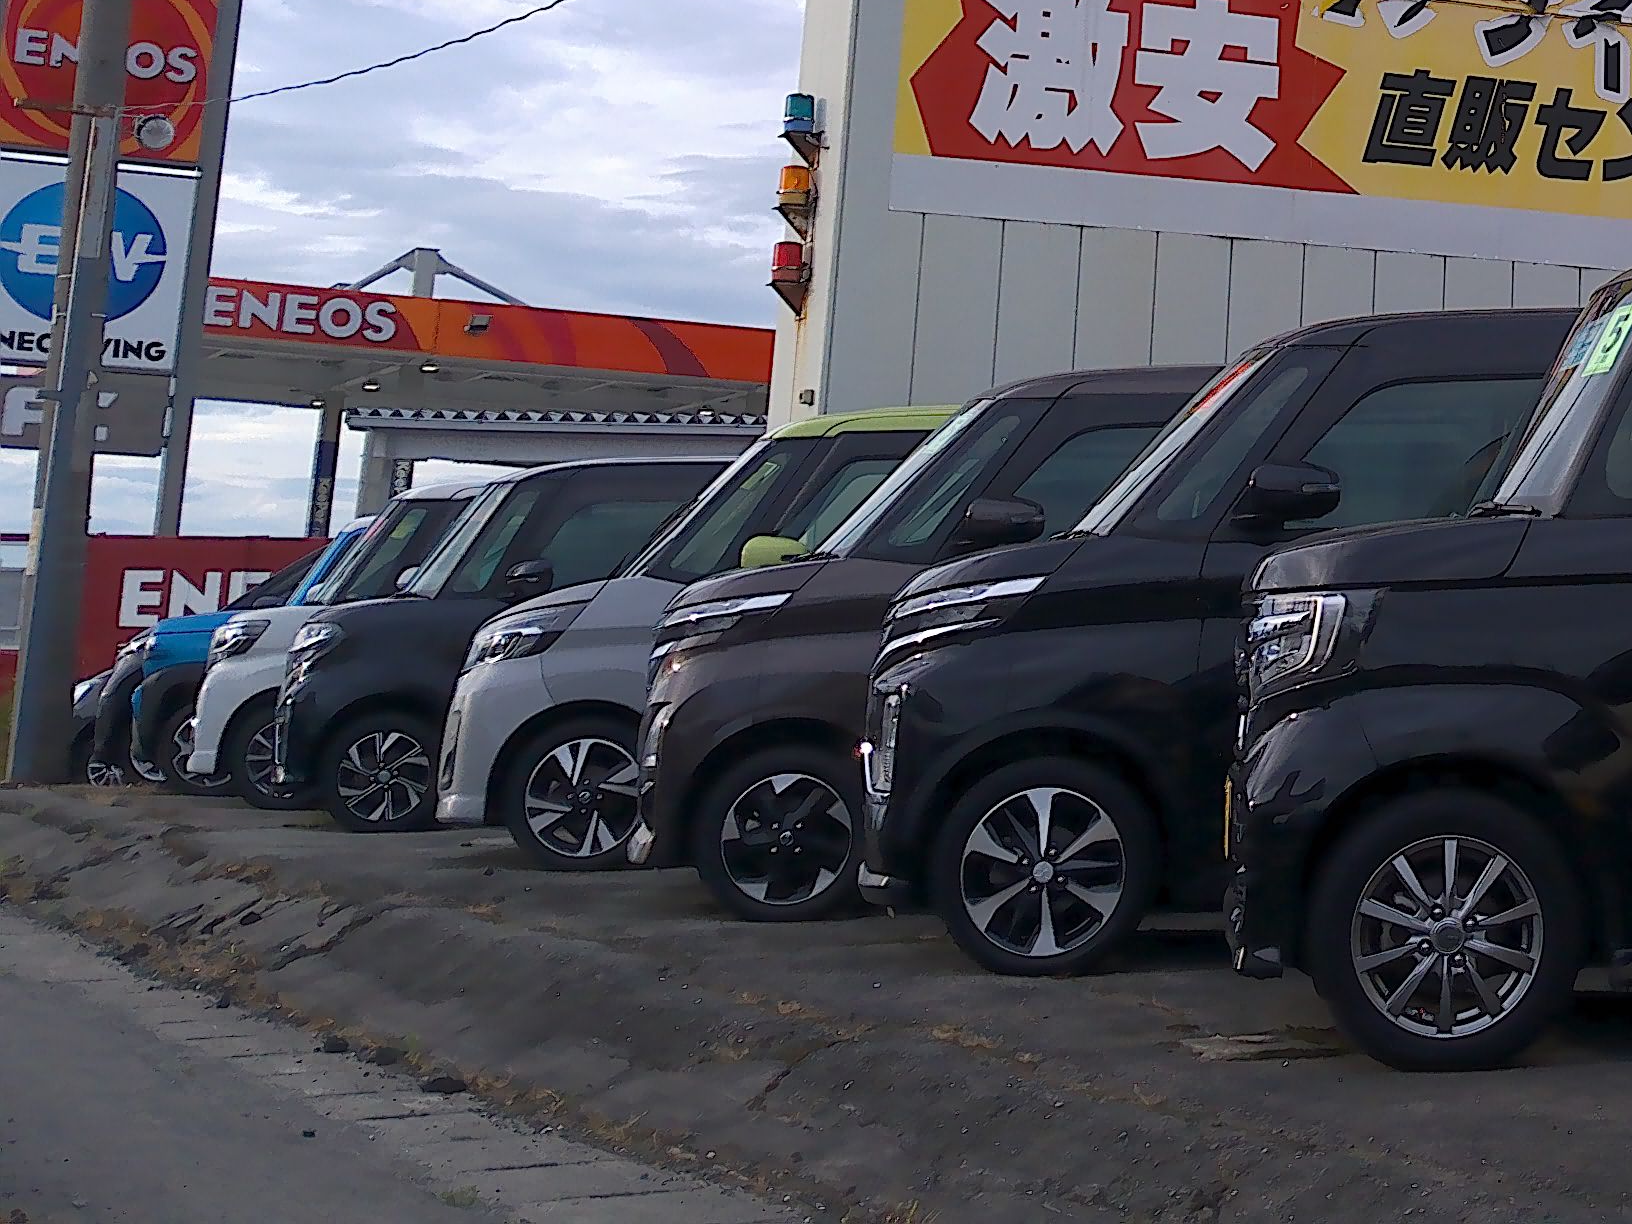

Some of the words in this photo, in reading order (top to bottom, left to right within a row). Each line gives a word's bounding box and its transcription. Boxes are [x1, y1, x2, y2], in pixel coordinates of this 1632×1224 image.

[14, 27, 197, 83] ENOS
[203, 285, 397, 342] ENEOS
[1602, 313, 1632, 354] 5
